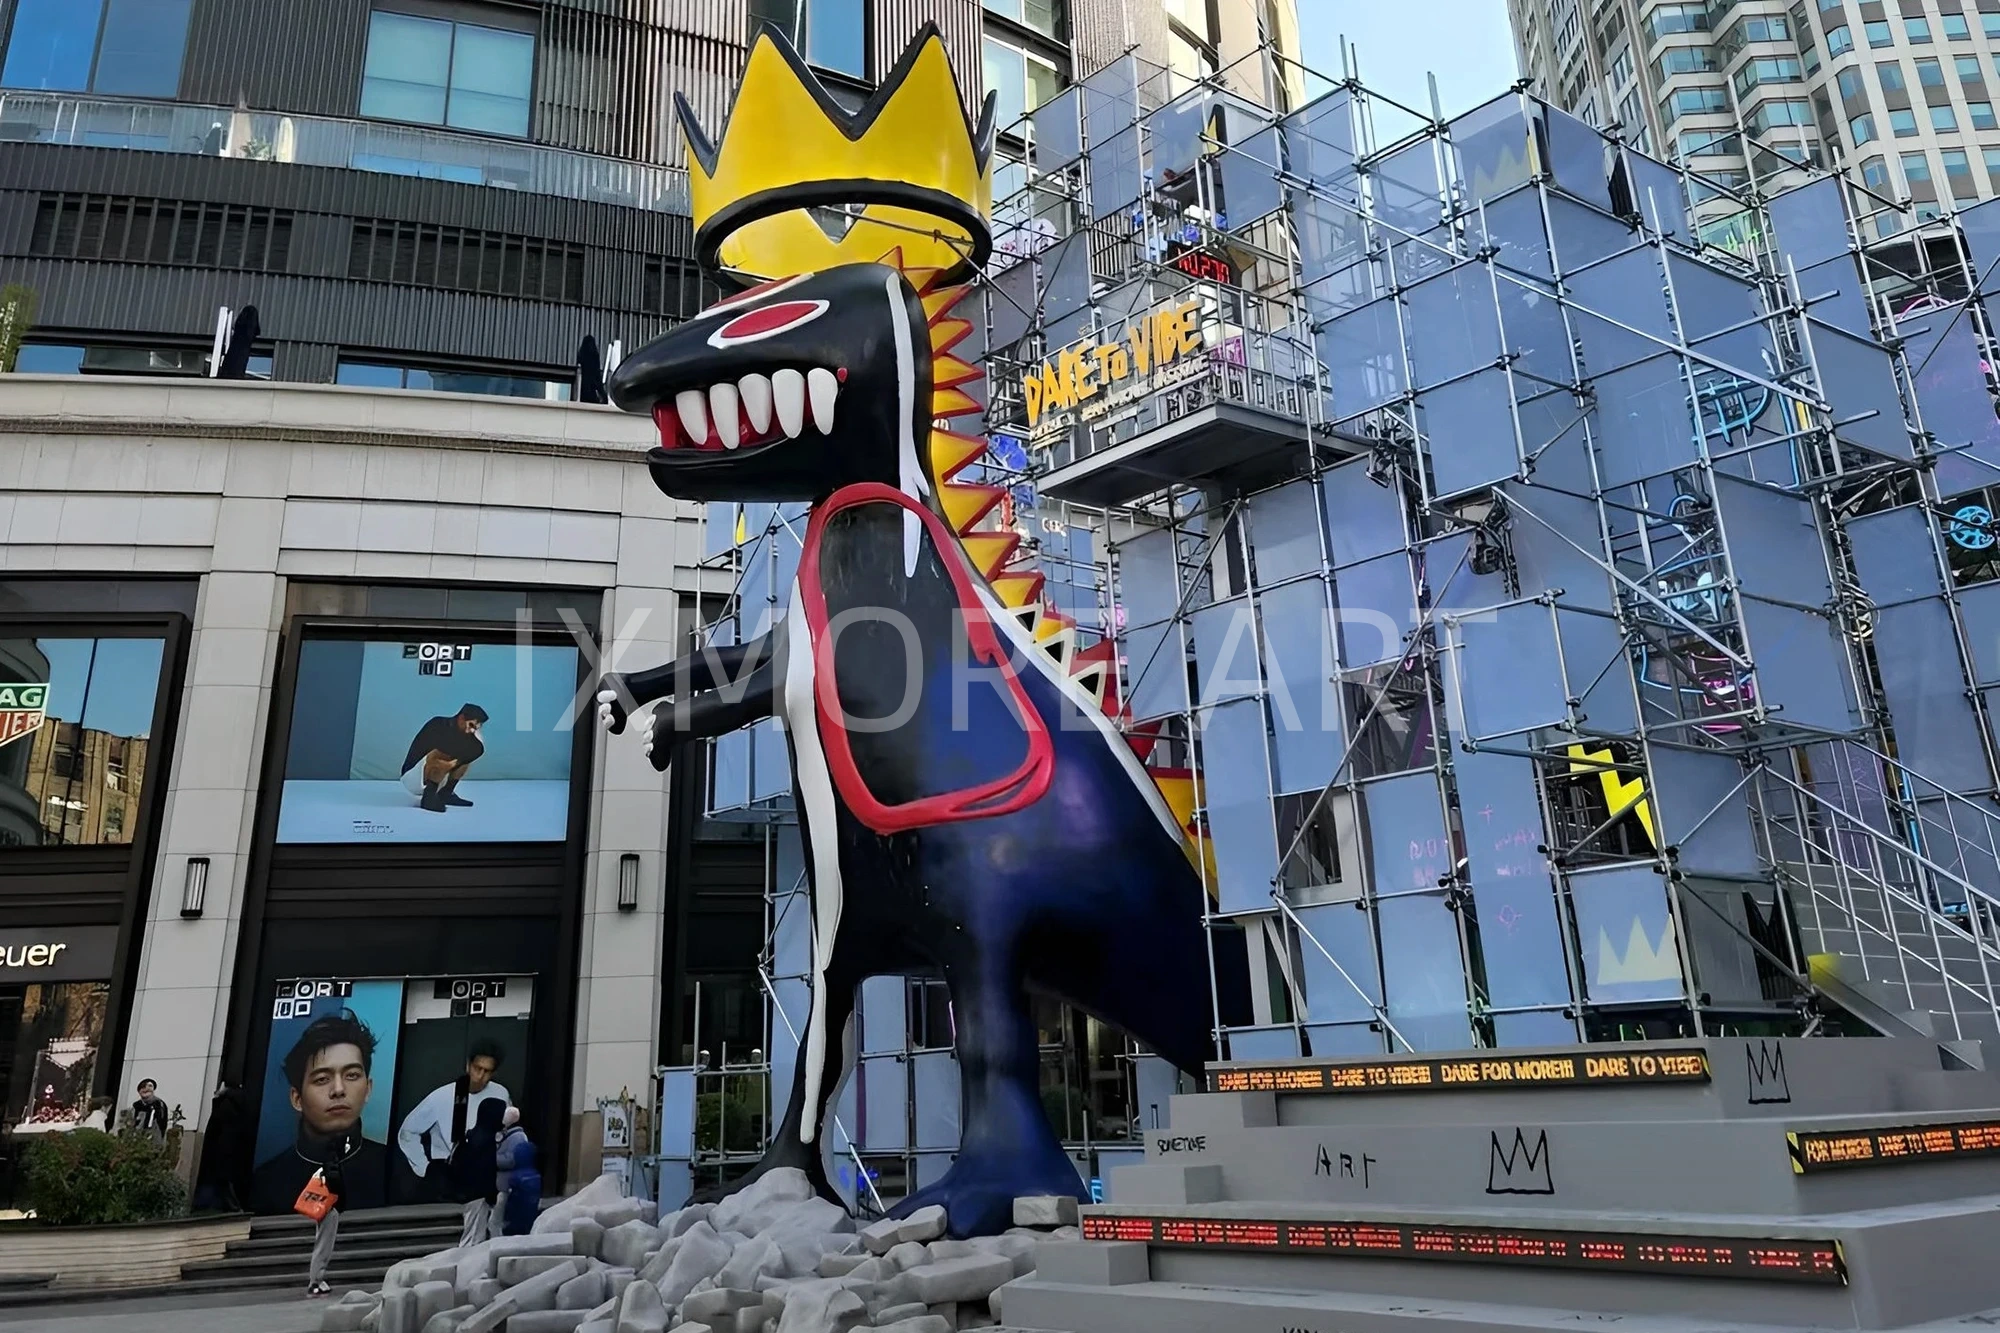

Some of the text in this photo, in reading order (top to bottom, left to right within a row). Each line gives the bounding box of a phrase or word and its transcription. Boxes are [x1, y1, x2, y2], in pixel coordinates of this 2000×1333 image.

[1129, 300, 1203, 377] VIBE
[1441, 1063, 1480, 1082] DARE
[1481, 1061, 1513, 1081] FOR
[1585, 1057, 1630, 1078] DARE
[1630, 1055, 1657, 1077] TO
[1314, 1143, 1377, 1189] ART
